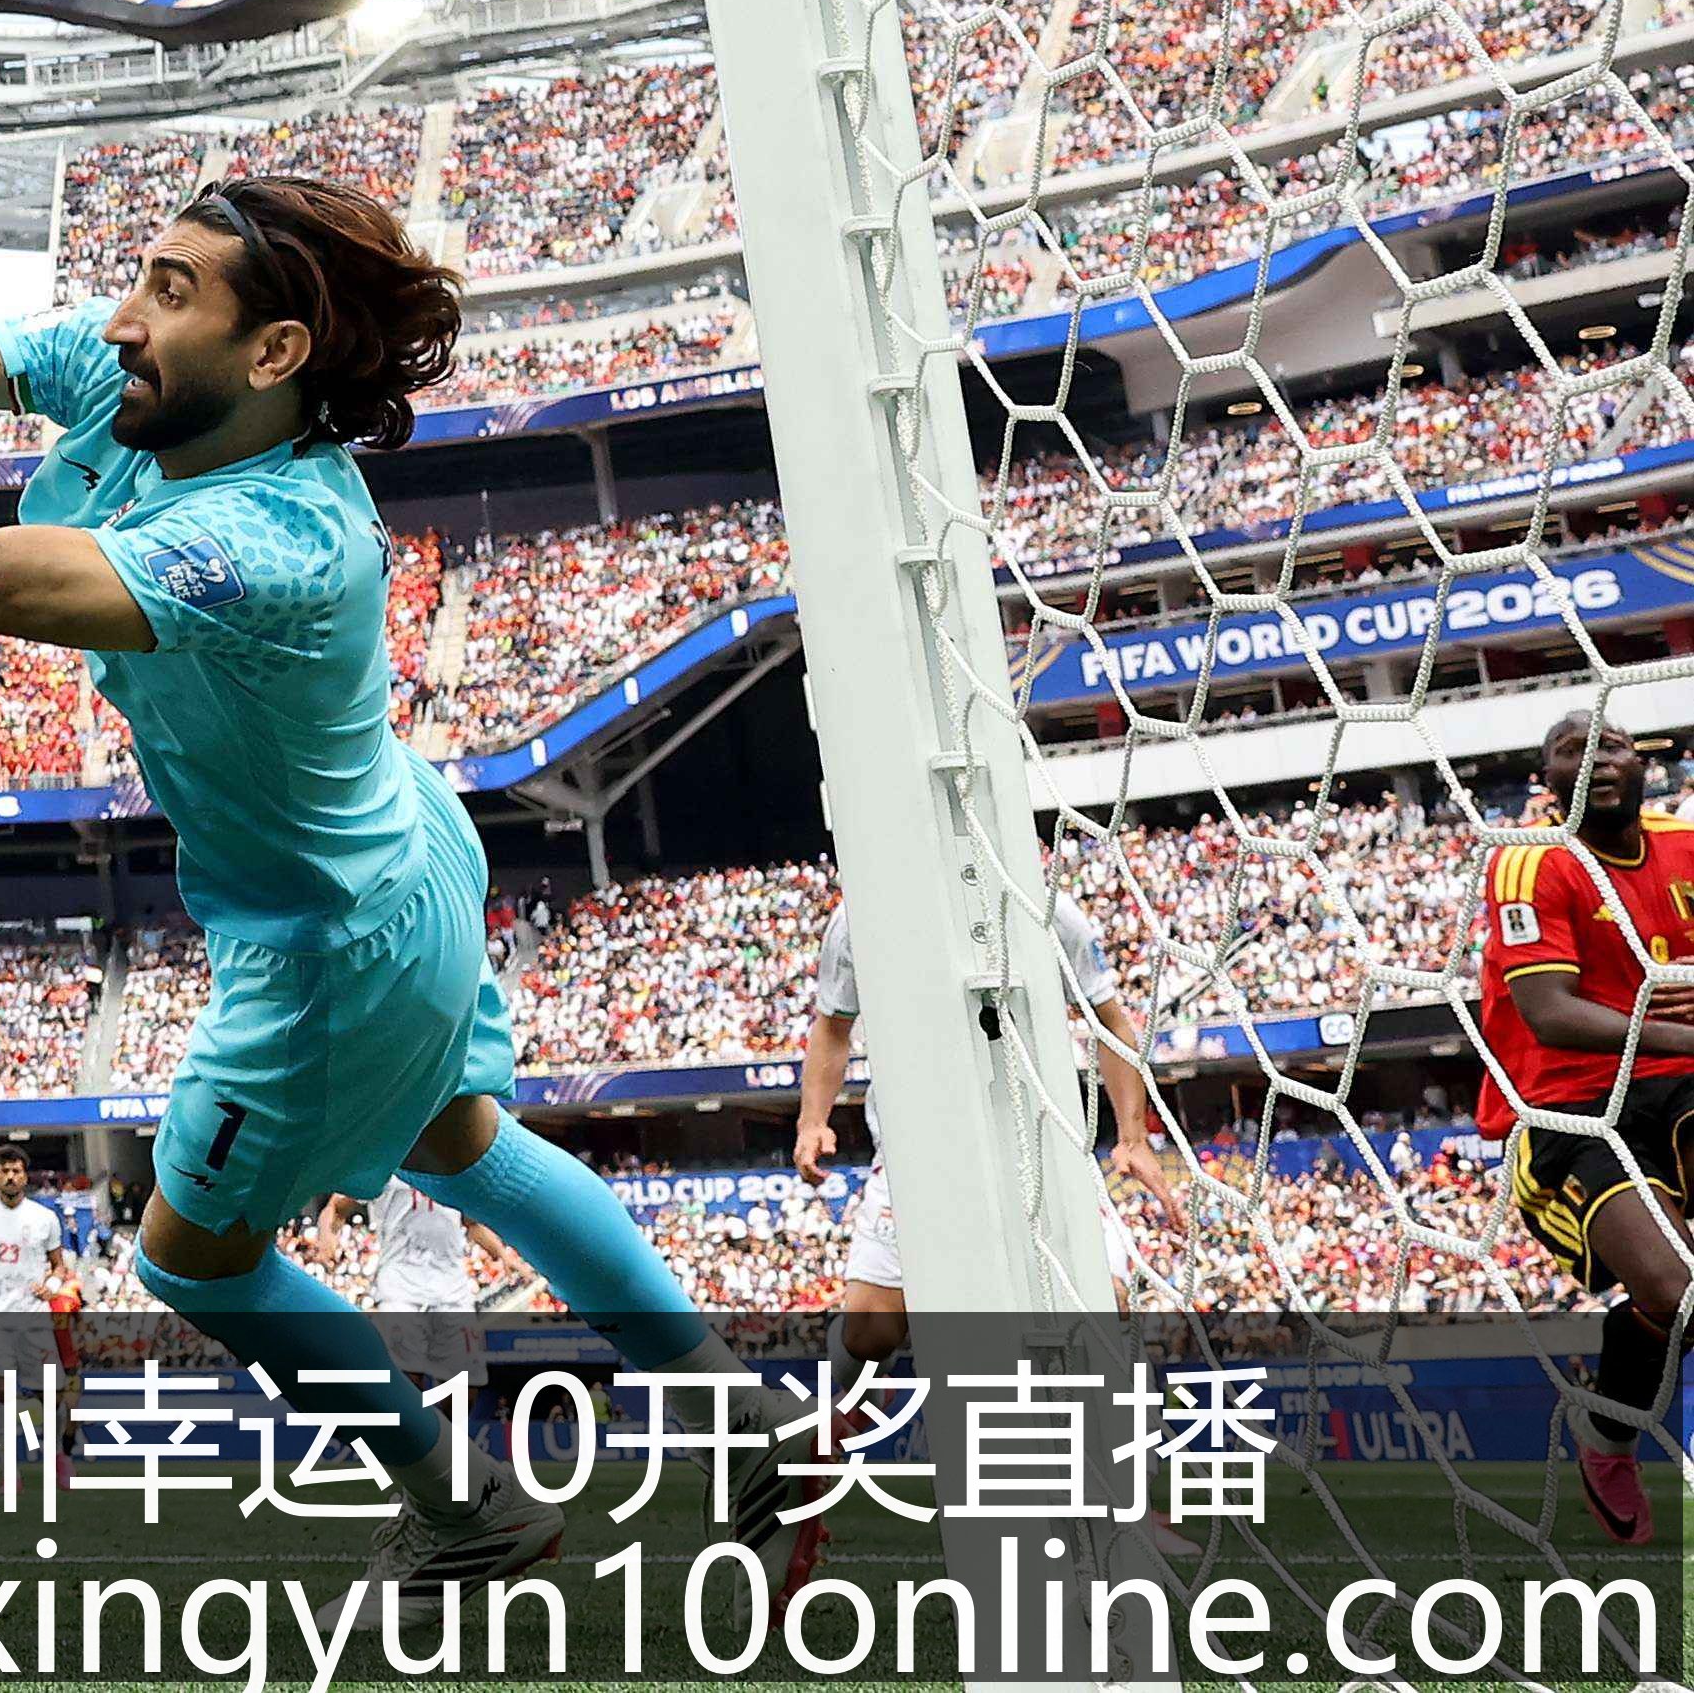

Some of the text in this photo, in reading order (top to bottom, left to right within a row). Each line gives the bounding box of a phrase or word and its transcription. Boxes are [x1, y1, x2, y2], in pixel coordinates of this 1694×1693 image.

[1081, 570, 1621, 688] FIFA WORLD CUP 2026
[205, 1101, 248, 1172] 1
[613, 1178, 671, 1206] RLD
[673, 1175, 735, 1204] CUP
